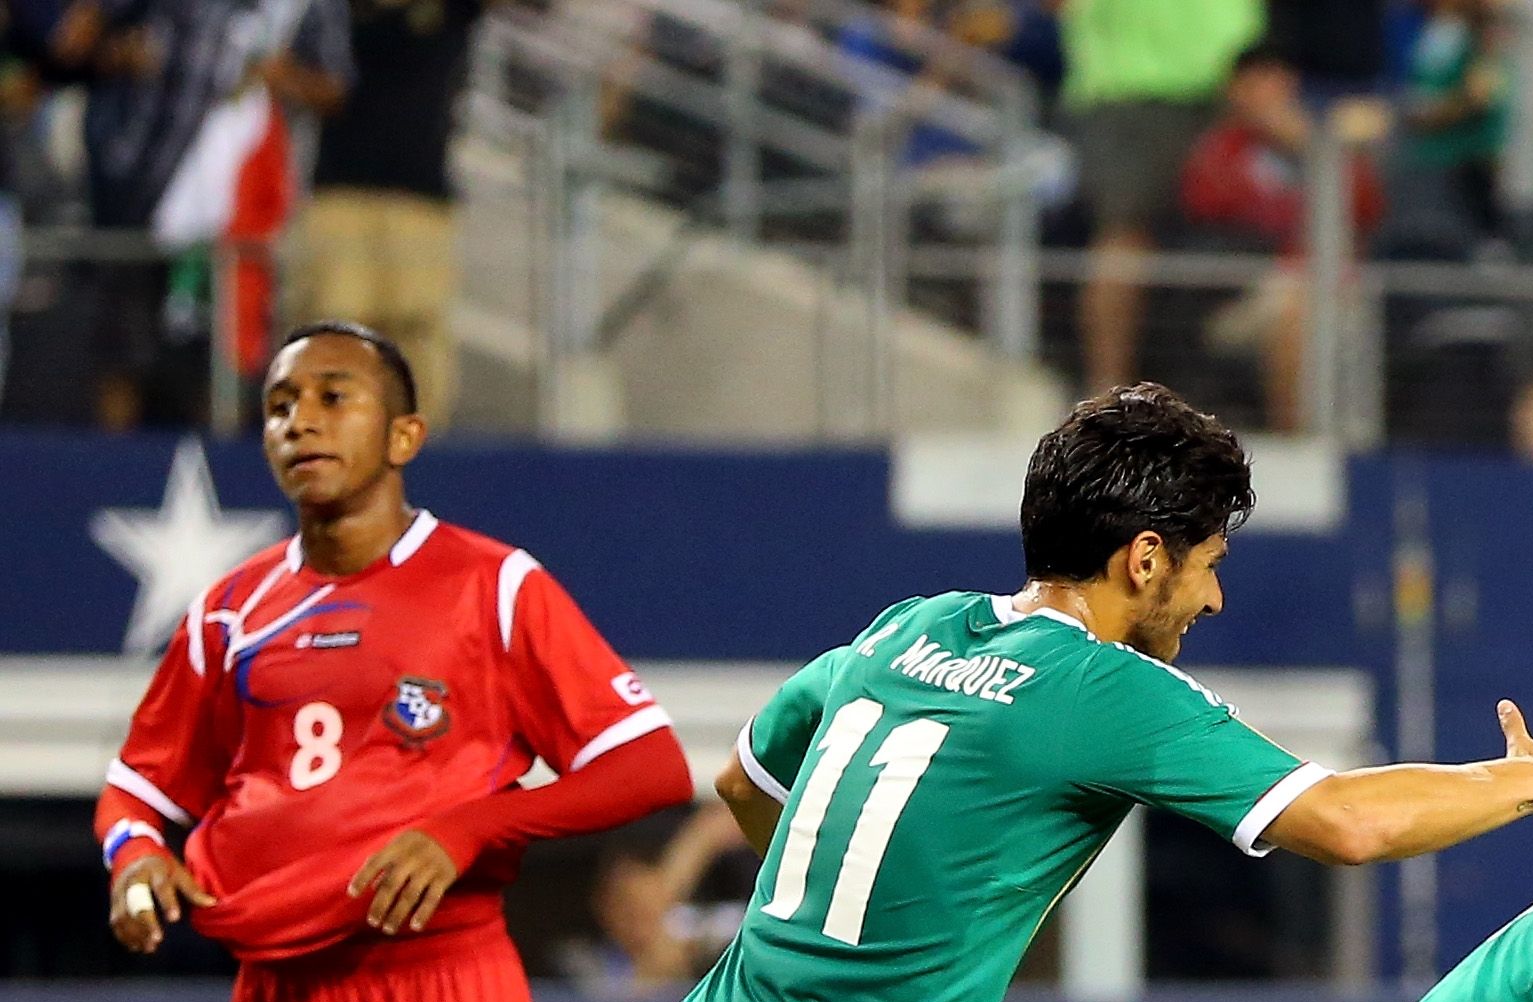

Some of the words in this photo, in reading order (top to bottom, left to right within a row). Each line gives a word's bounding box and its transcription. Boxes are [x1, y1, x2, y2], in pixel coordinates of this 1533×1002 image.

[889, 634, 1036, 705] MARQUEZ
[289, 701, 344, 790] 8
[761, 697, 950, 946] 11
